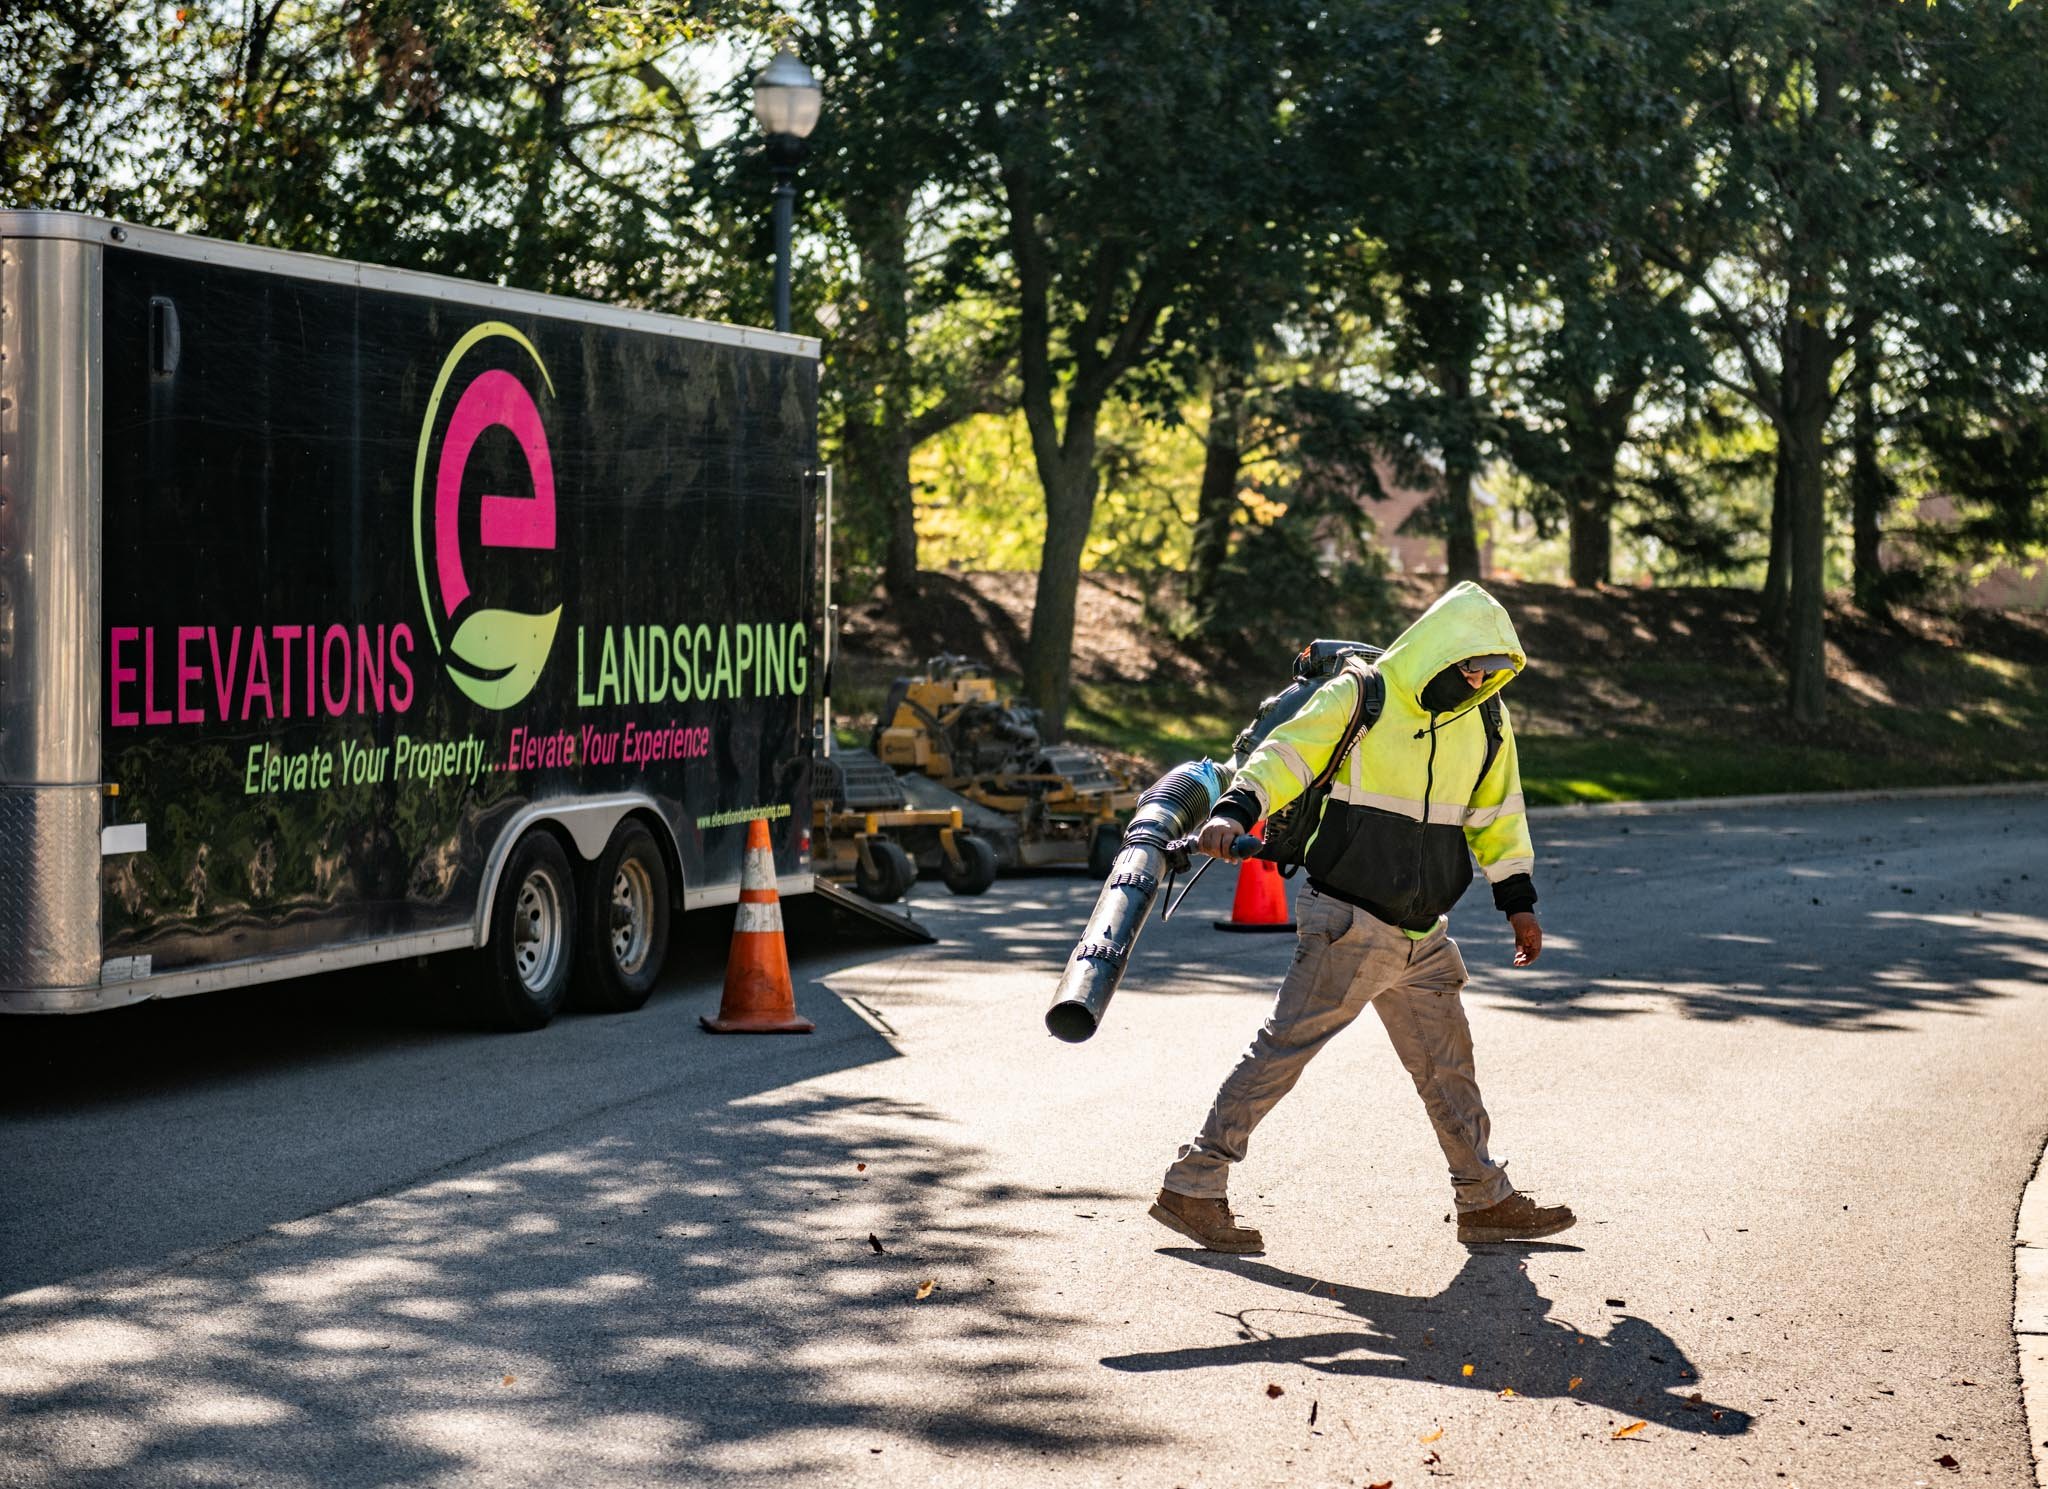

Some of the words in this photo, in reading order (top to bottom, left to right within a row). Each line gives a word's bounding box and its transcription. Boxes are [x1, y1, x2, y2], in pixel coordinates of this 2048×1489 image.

[111, 622, 414, 726] ELEVATIONS
[577, 621, 807, 707] LANDSCAPING
[245, 743, 333, 795] Elevate
[341, 740, 391, 787] Your
[581, 724, 621, 766] Your
[622, 721, 710, 773] Experience
[696, 803, 791, 830] www.elevationslandscaping.com
